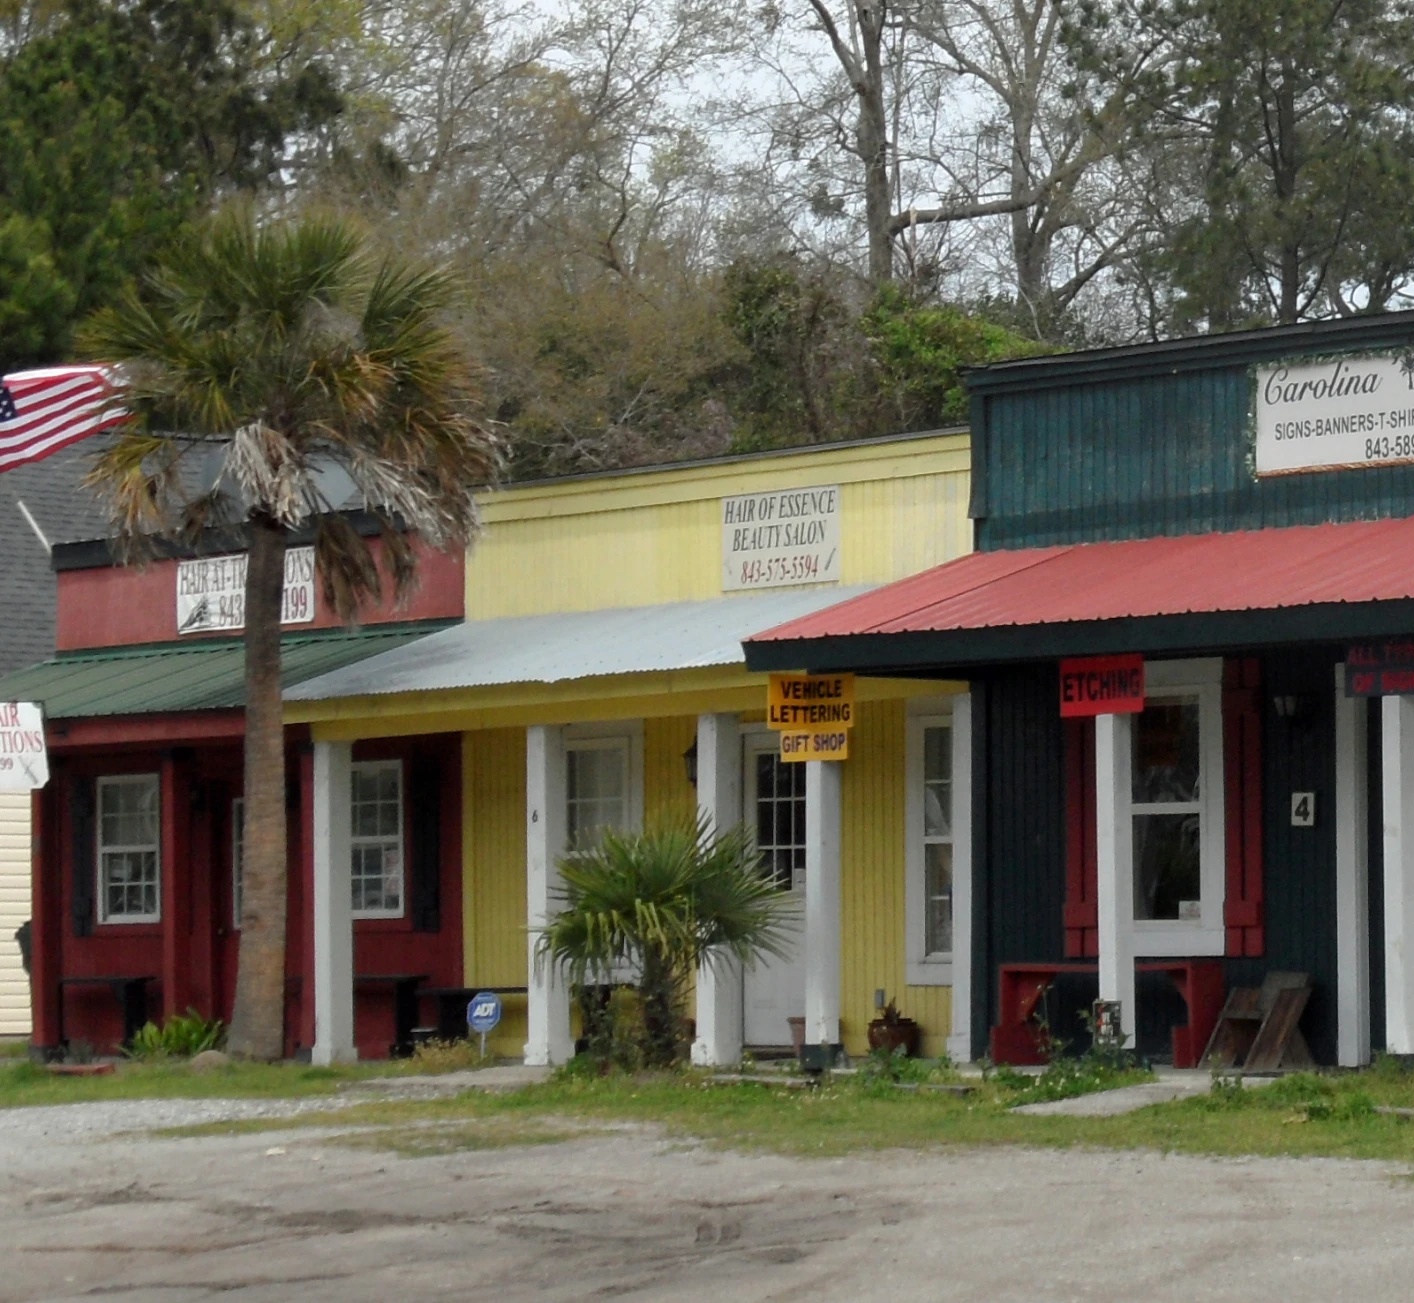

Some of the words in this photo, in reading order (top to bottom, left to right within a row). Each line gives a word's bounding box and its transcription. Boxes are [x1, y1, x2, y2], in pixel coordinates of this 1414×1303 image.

[1264, 362, 1384, 405] Carolina
[725, 499, 755, 524] HAIR
[759, 497, 776, 520] OF
[778, 490, 835, 519] ESSENCE
[732, 525, 782, 551] BEAUTY
[784, 520, 826, 546] SALON
[180, 562, 208, 595] HAIR
[741, 555, 818, 584] 843-575-5594
[781, 680, 842, 699] VEHICLE
[1064, 668, 1140, 702] ETCHING
[770, 703, 850, 723] LETTERING
[782, 735, 809, 753] GIFT
[814, 733, 845, 752] SHOP
[532, 809, 538, 823] 6
[1295, 796, 1309, 821] 4
[473, 1003, 496, 1016] ADT
